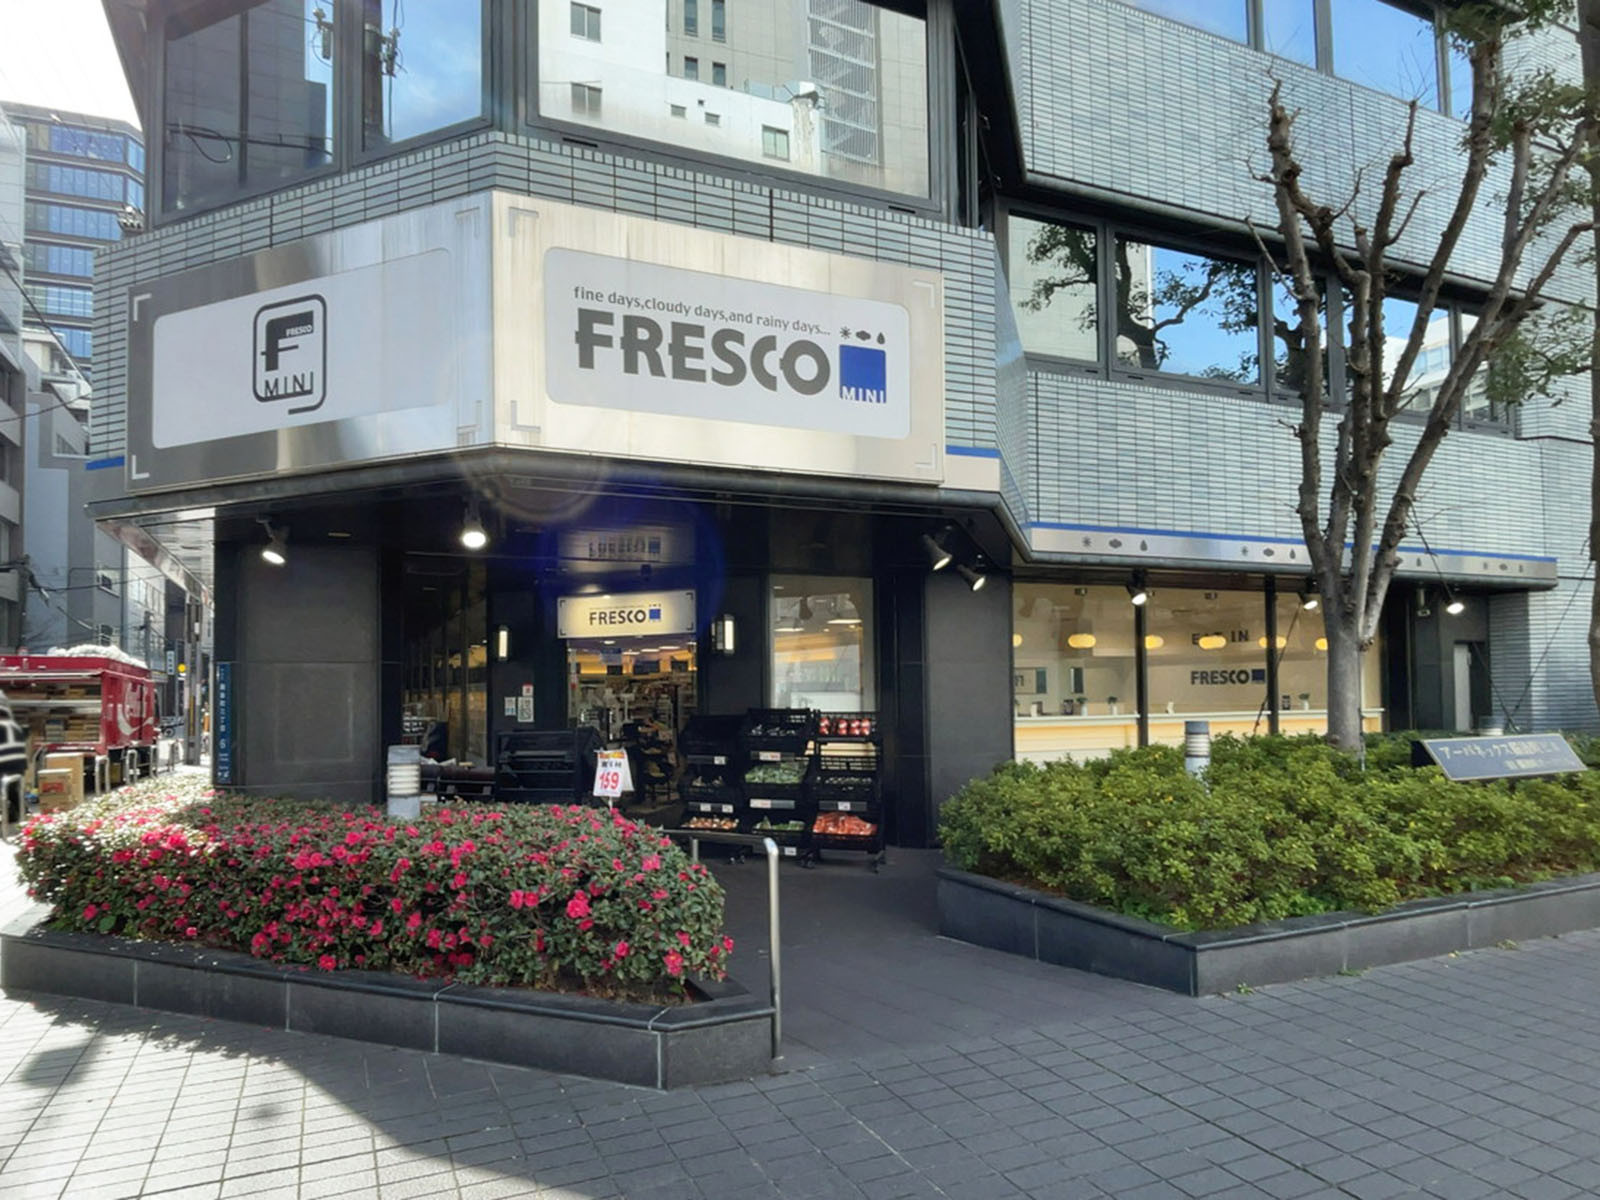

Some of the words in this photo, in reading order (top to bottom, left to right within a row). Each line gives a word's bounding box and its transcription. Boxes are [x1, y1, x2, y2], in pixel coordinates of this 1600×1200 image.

[574, 286, 604, 302] fine
[756, 315, 790, 331] rainy
[285, 324, 313, 337] FRESCO
[575, 307, 831, 396] FRESCO
[264, 371, 314, 398] MINI
[840, 385, 885, 404] MINI
[589, 609, 647, 626] FRESCO
[1231, 630, 1249, 643] IN
[1190, 669, 1250, 685] FRESCO
